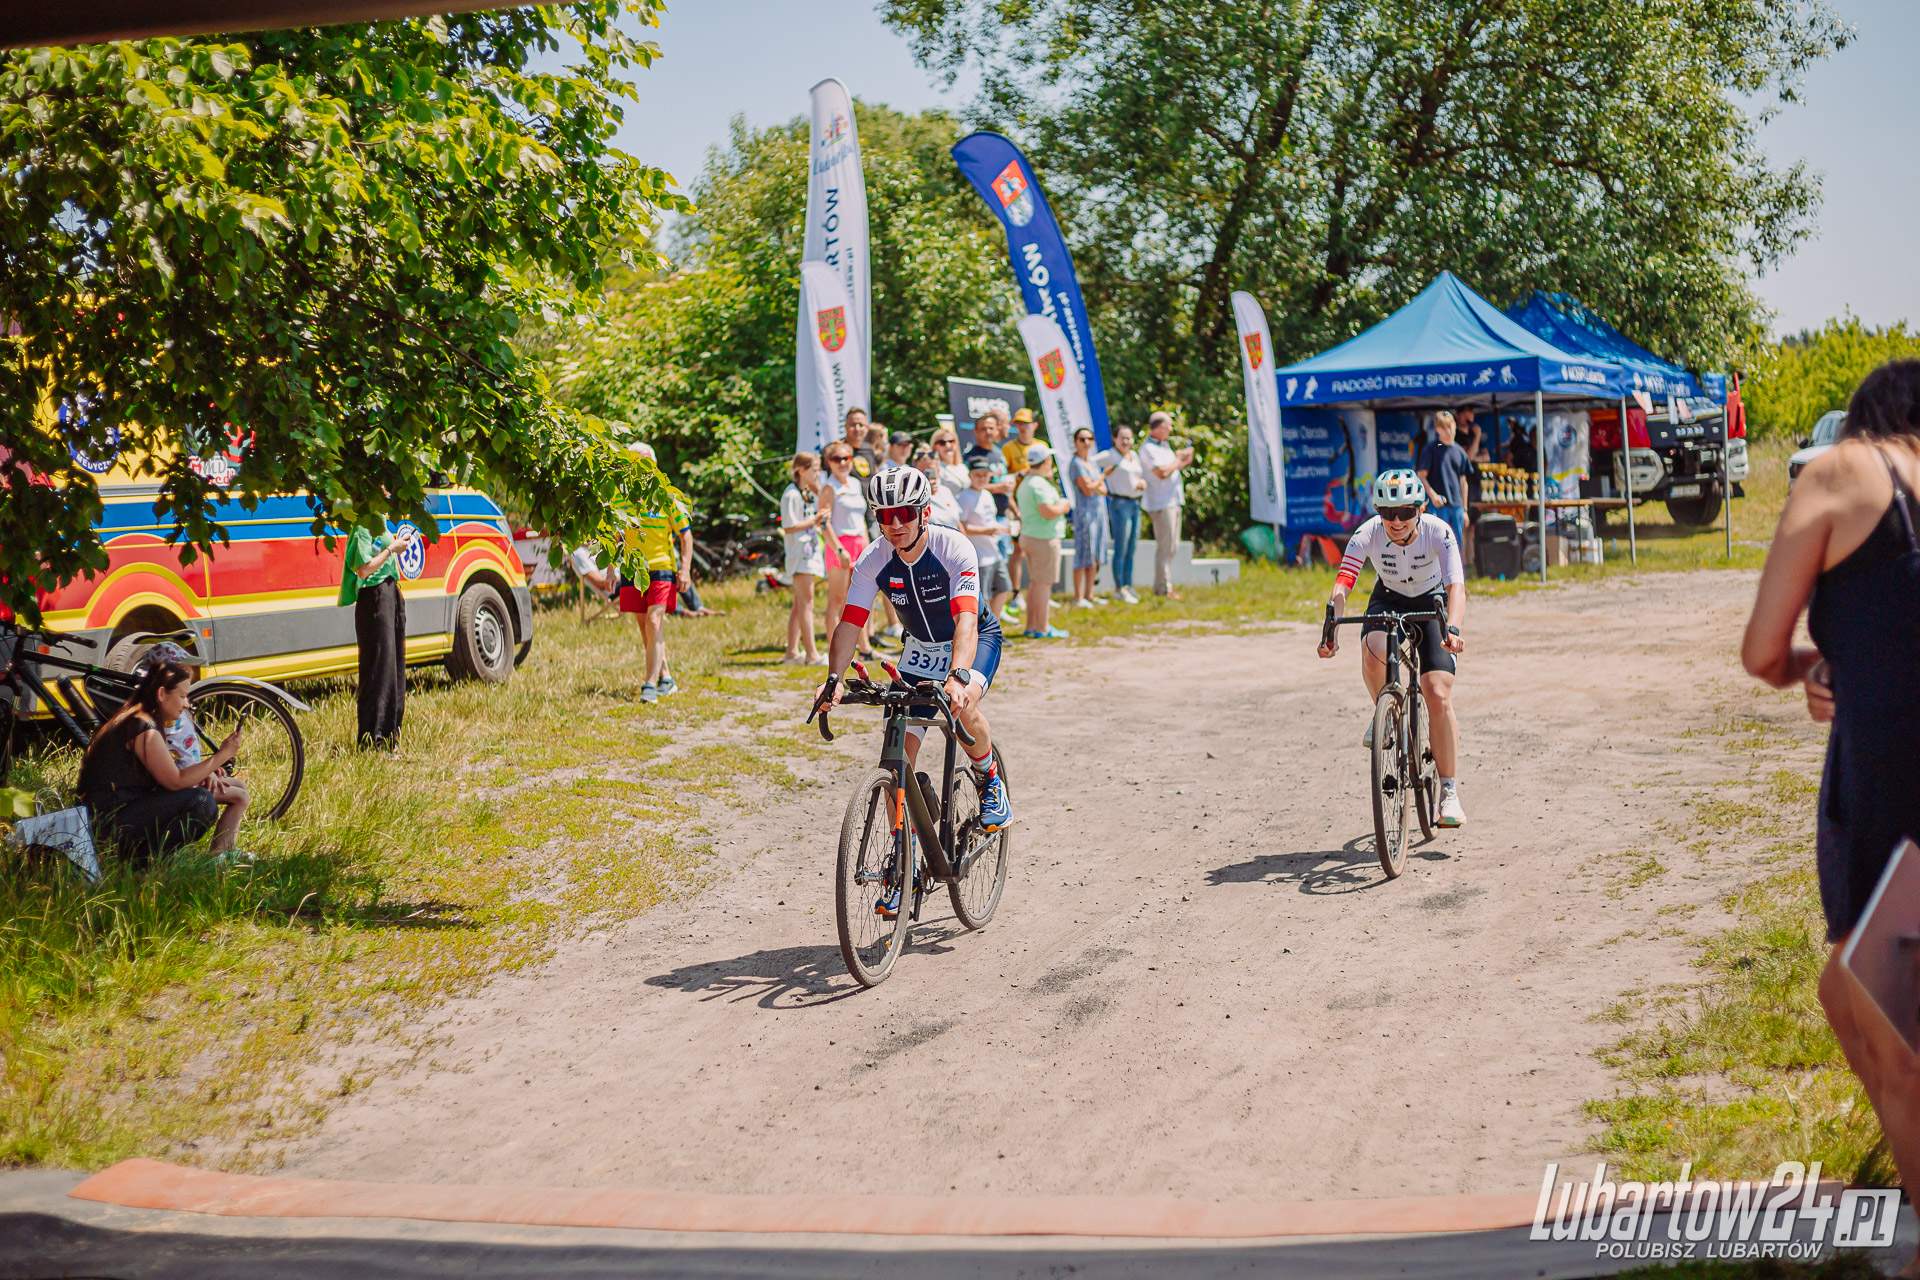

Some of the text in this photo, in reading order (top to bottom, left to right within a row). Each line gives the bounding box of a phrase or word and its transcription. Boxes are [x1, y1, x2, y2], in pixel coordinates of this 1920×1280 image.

[822, 188, 839, 271] RTÓW
[1384, 374, 1424, 389] PRZEZ
[1426, 373, 1467, 387] SPORT
[908, 650, 948, 672] 33/1
